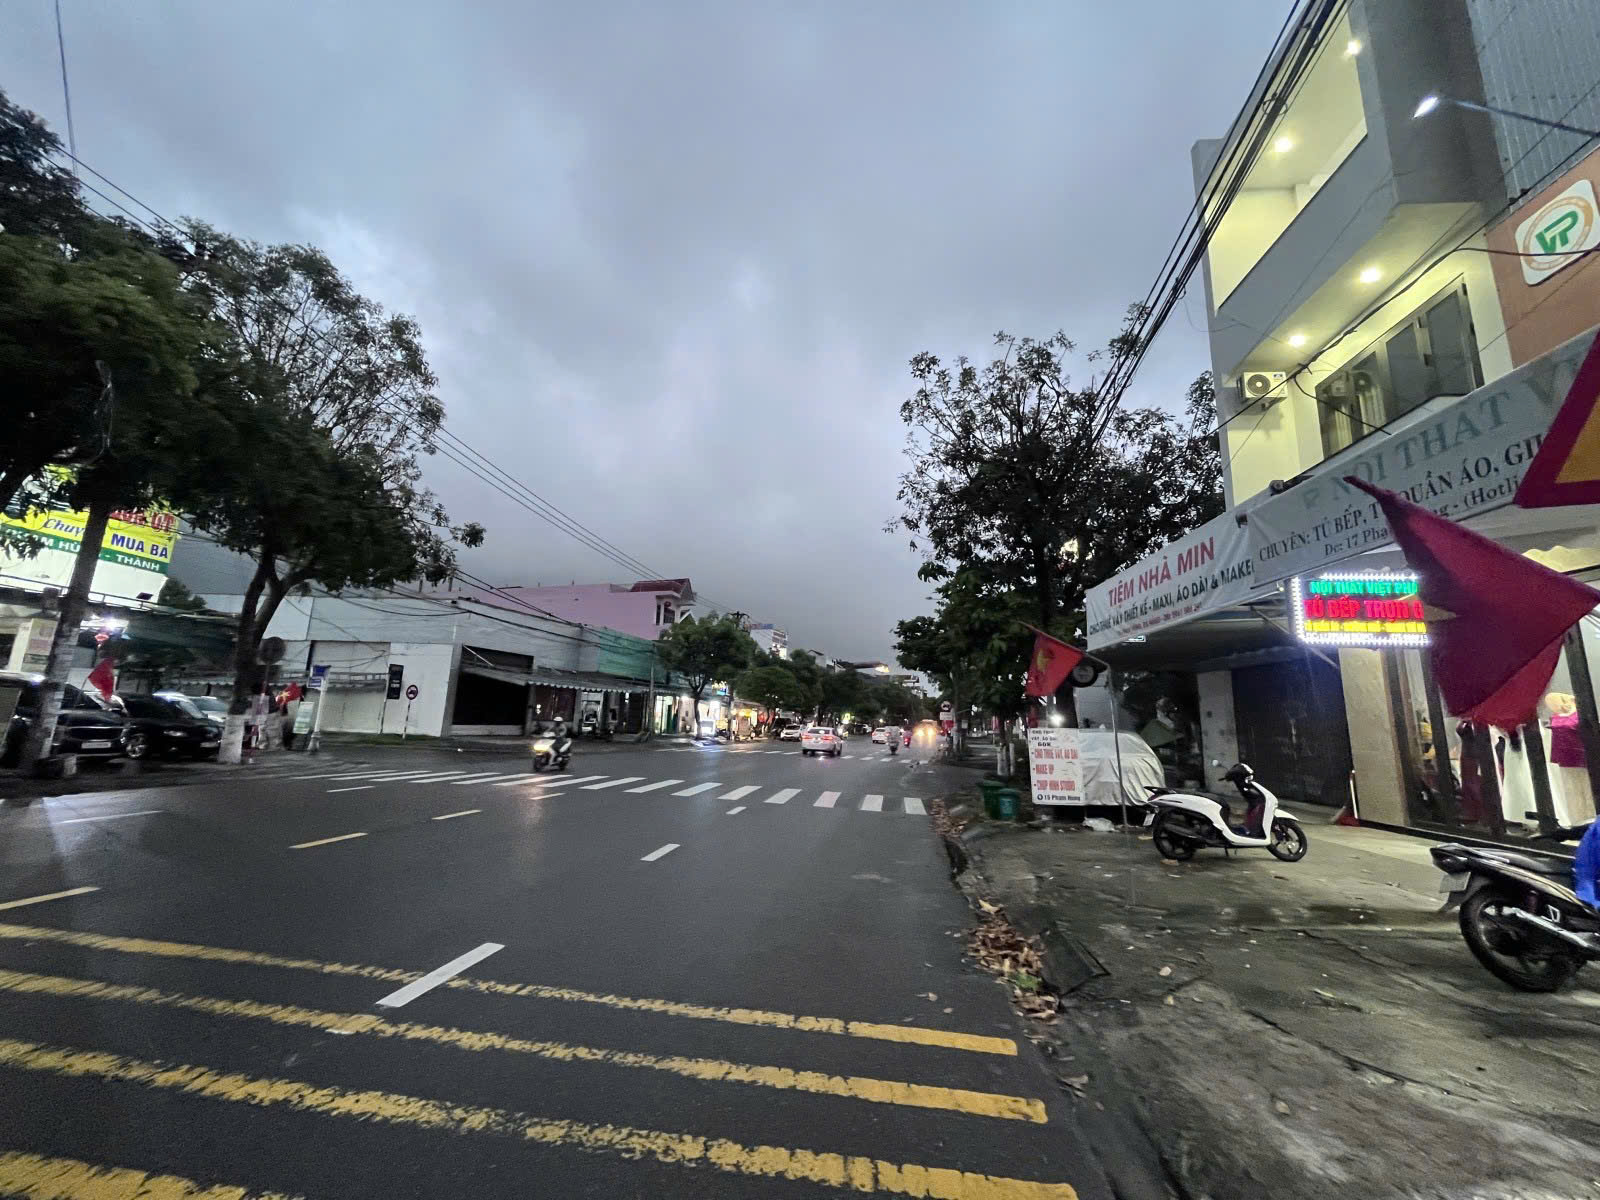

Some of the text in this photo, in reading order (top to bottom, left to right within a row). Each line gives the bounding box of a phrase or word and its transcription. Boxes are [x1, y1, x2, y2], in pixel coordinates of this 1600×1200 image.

[43, 517, 85, 537] Chuy
[1346, 535, 1359, 549] 17
[1362, 526, 1389, 544] Phạ
[1463, 479, 1520, 509] (Hotli
[111, 533, 145, 553] MUA
[1138, 555, 1172, 594] NHÀ
[1177, 536, 1215, 576] MIN
[1176, 586, 1190, 603] ÁO
[1211, 574, 1219, 590] &
